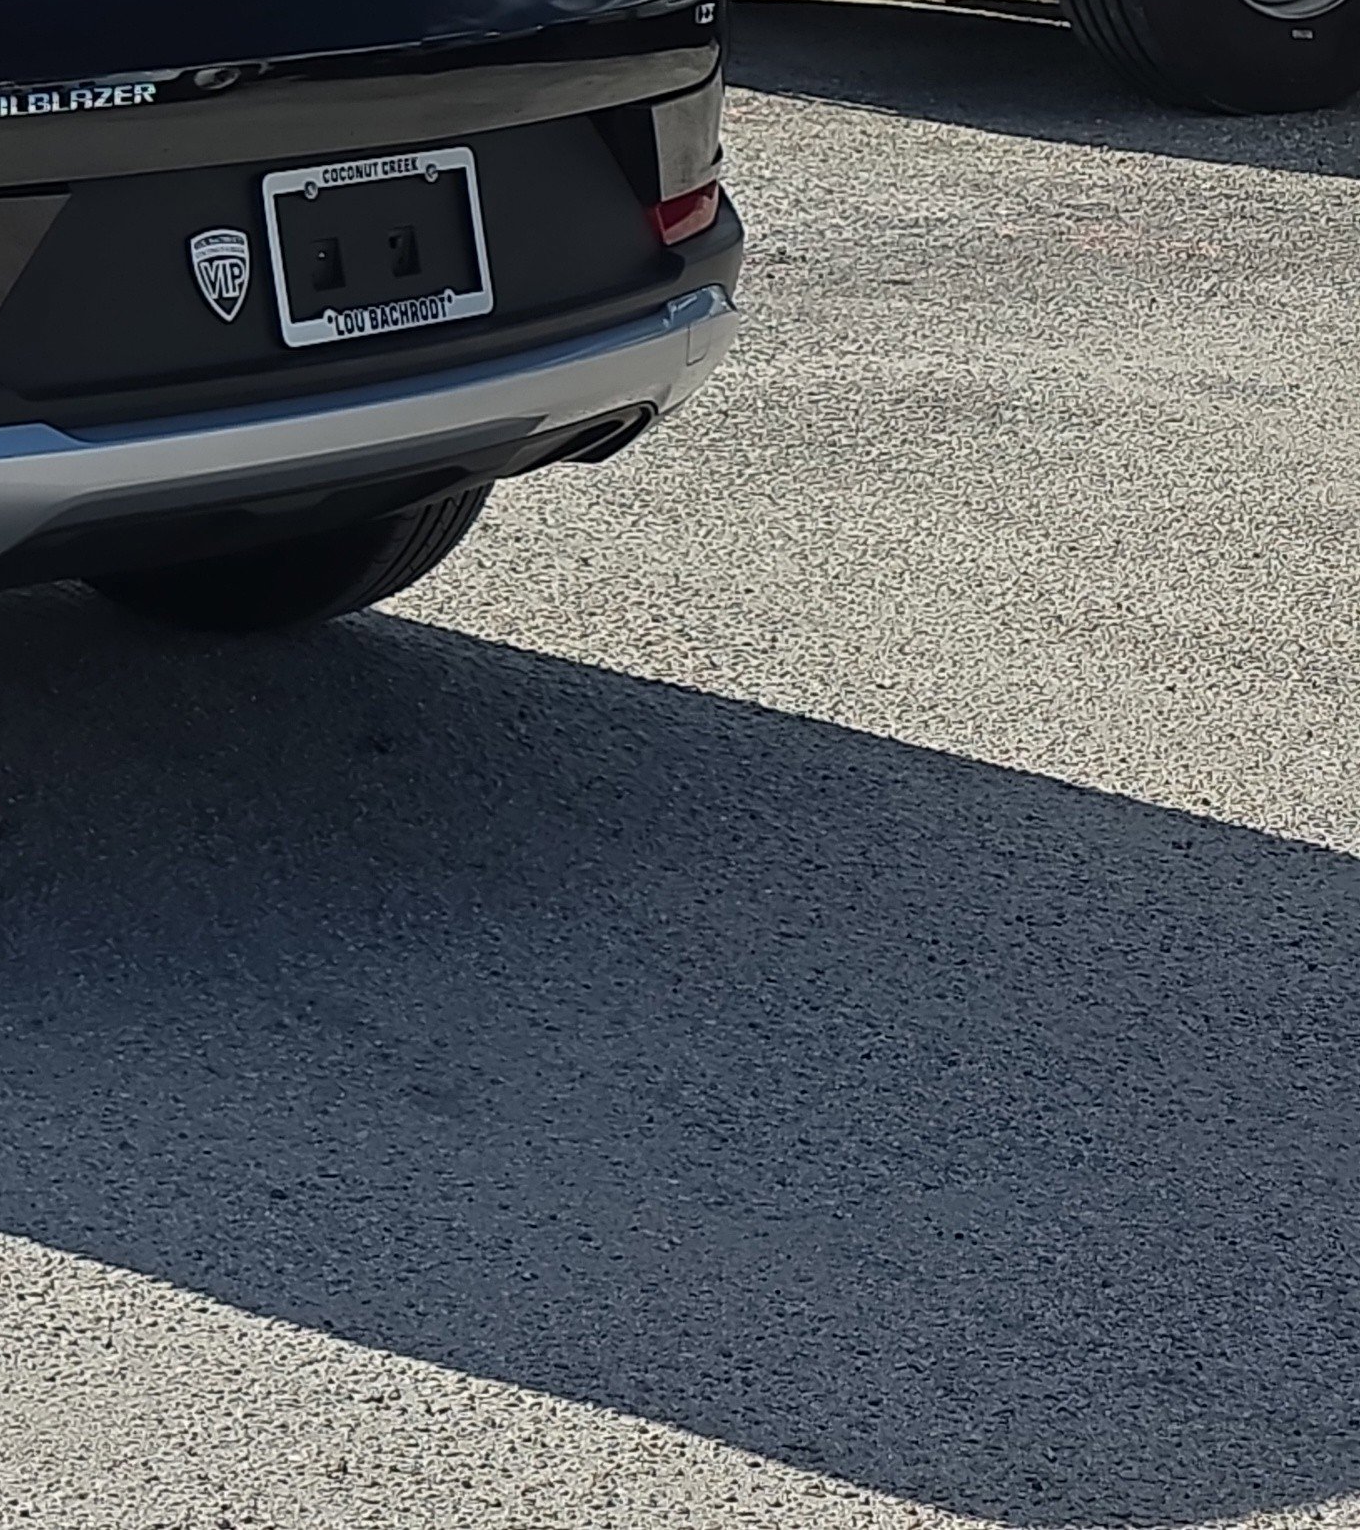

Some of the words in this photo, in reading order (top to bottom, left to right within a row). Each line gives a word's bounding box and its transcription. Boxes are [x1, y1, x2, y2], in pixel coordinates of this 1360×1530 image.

[322, 162, 379, 184] COCONUT
[382, 156, 419, 176] CREEK
[200, 259, 245, 299] VIP
[335, 310, 366, 336] LOU
[370, 296, 448, 331] BACHRODT
